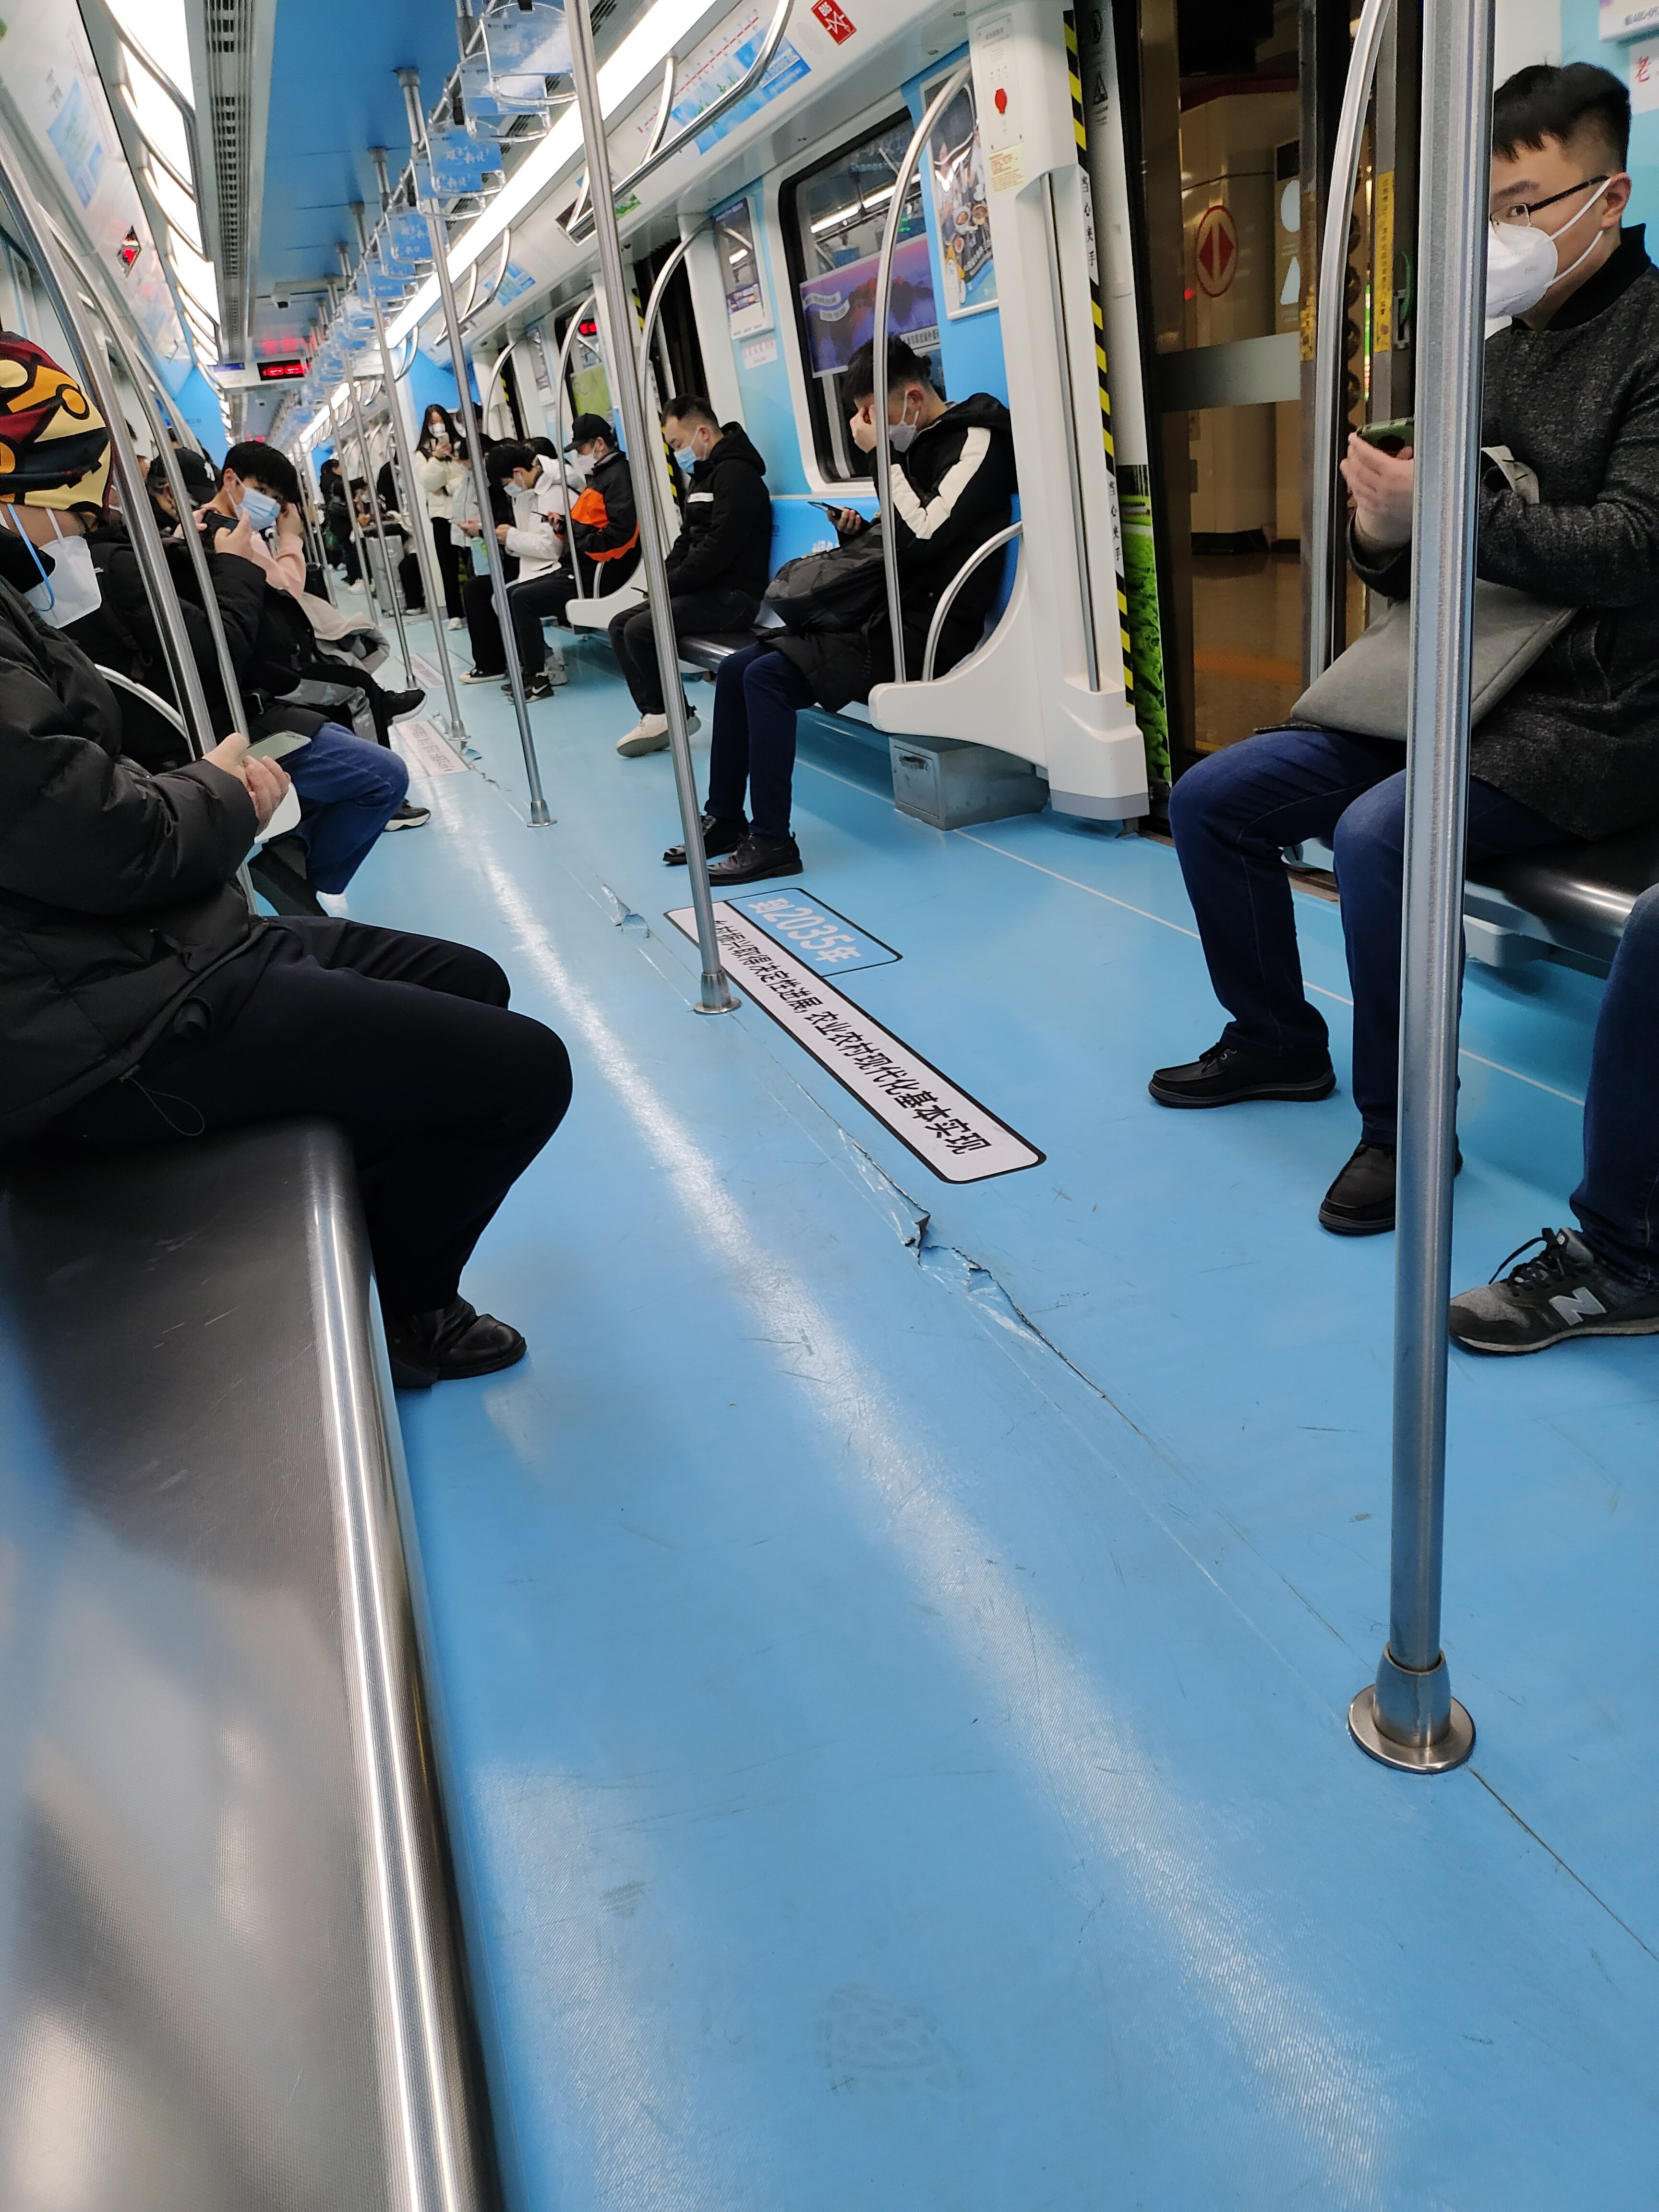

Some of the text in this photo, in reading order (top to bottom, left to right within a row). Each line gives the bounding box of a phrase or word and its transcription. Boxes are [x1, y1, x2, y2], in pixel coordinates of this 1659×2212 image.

[1082, 176, 1096, 266] 当心夹手
[1109, 481, 1121, 561] 当心夹手
[747, 898, 863, 963] 到2035年
